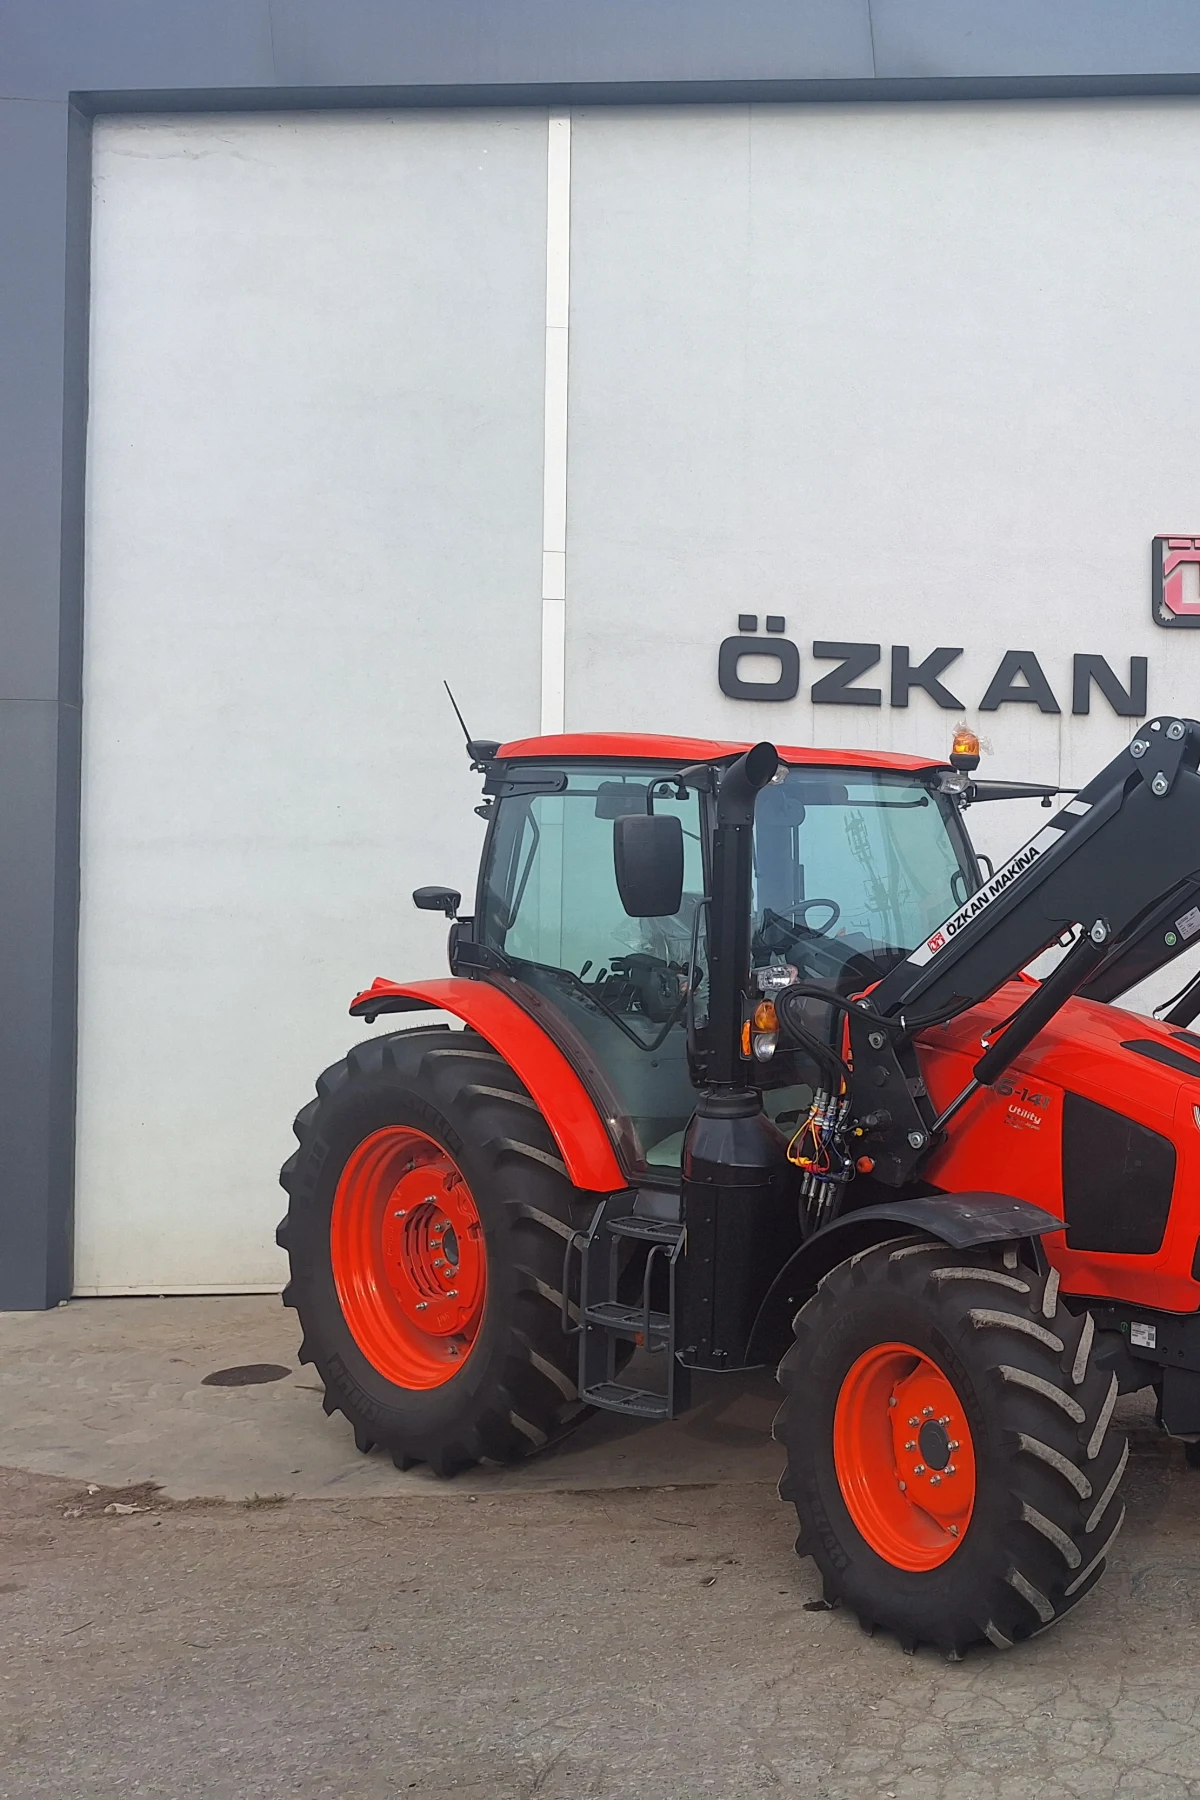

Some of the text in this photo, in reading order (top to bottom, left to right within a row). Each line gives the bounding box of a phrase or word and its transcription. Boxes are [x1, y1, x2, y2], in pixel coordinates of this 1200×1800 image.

[718, 614, 1148, 717] ÖZKAN
[946, 892, 990, 937] ÖZKAN
[988, 846, 1041, 898] MAKİNA
[1008, 1104, 1042, 1125] Utility
